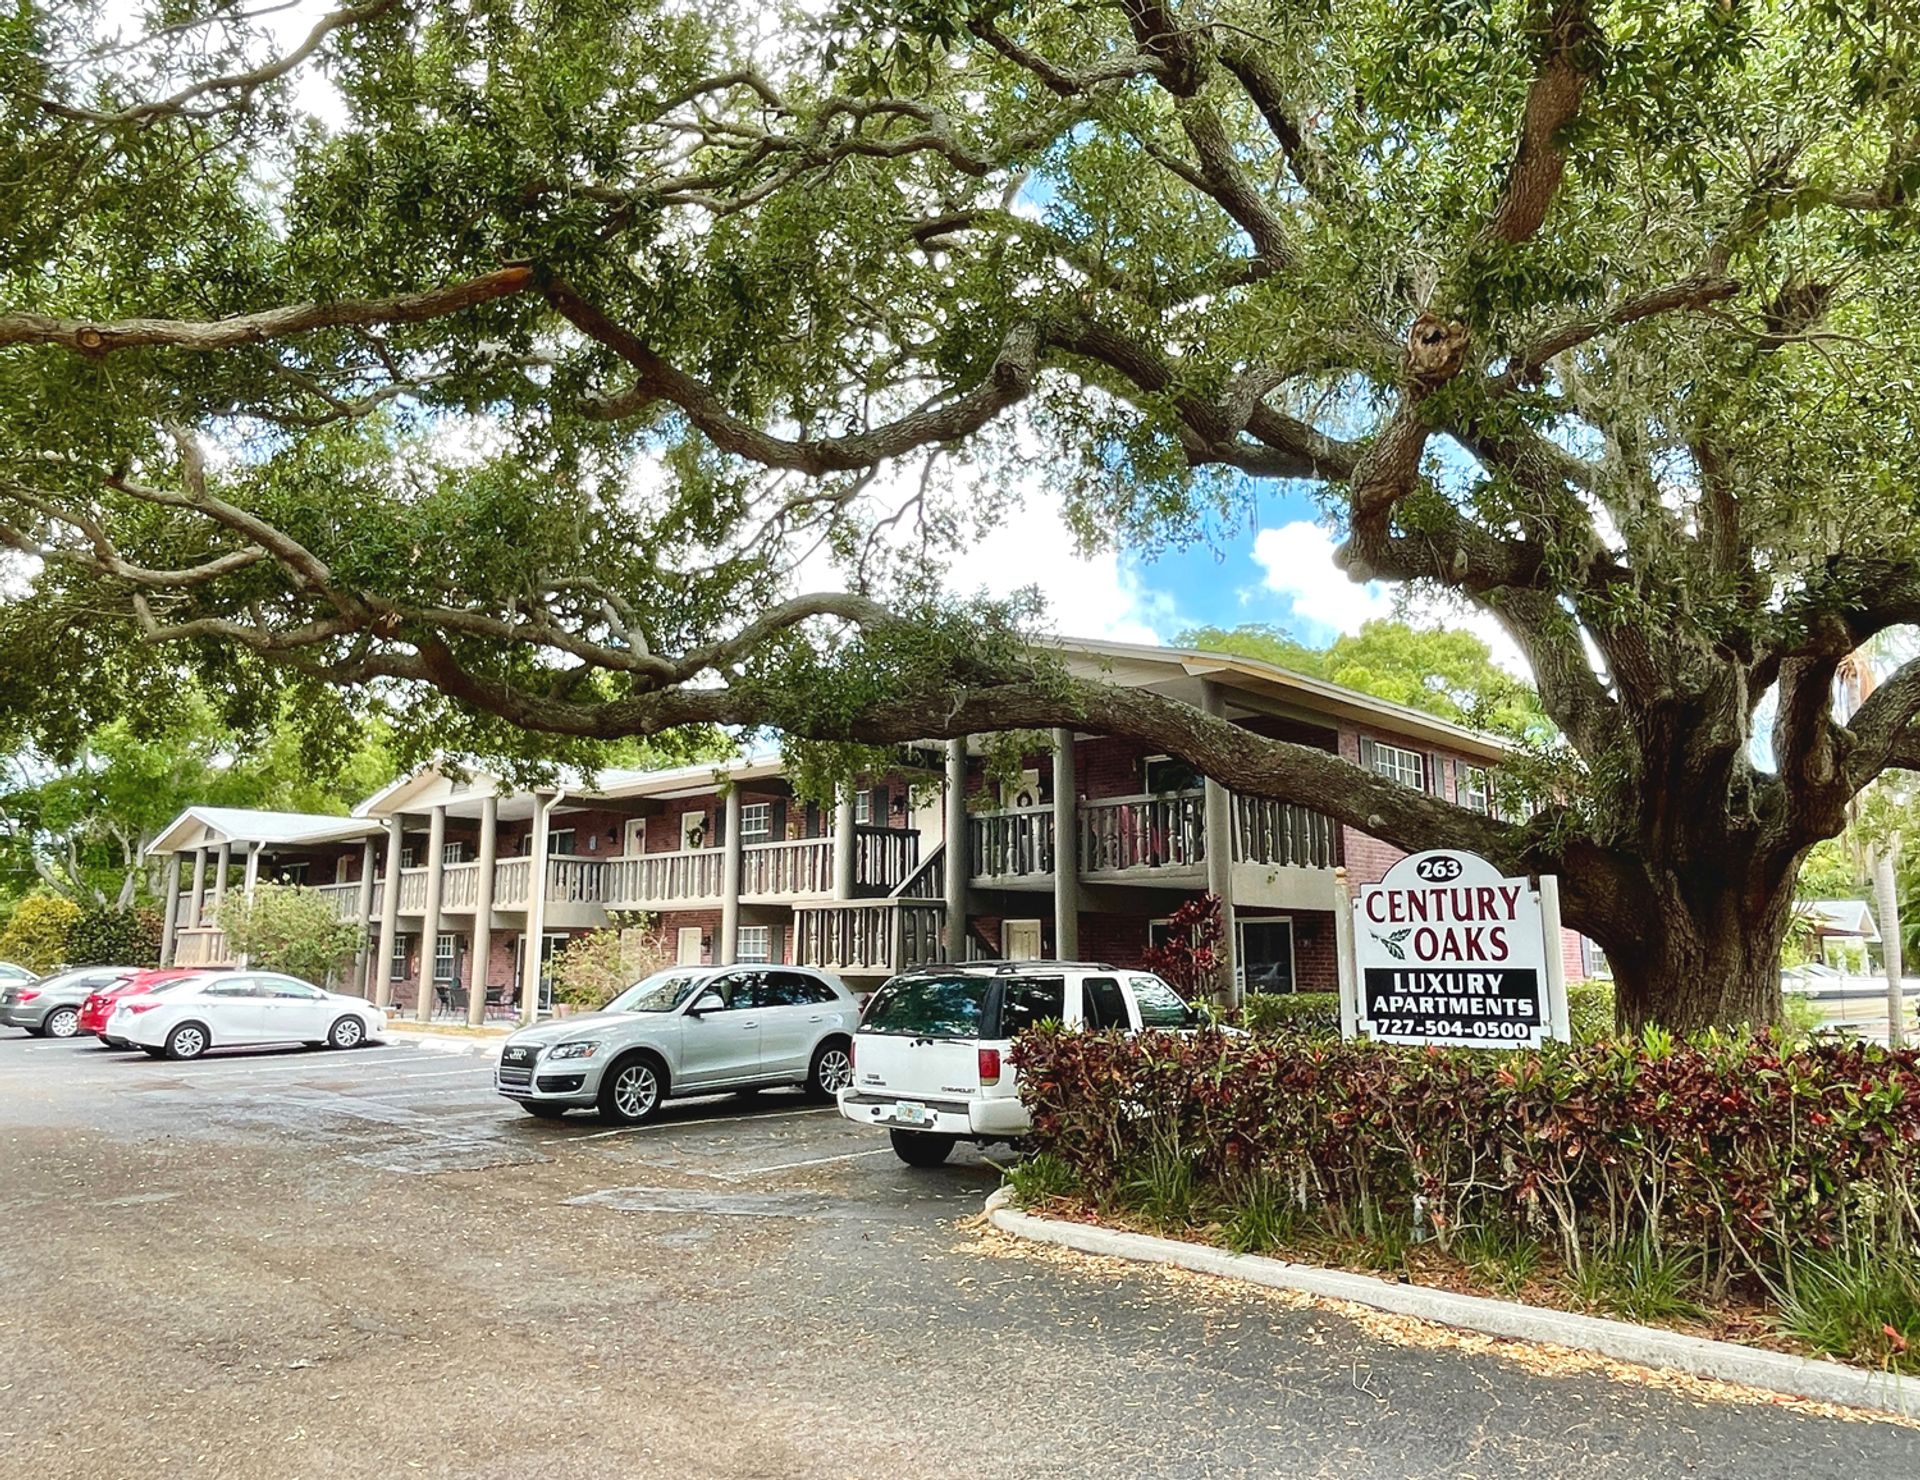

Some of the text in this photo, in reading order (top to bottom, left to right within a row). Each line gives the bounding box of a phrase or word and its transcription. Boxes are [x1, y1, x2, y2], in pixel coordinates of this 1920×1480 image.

[1420, 861, 1460, 878] 263
[1366, 886, 1521, 922] CENTURY
[1414, 927, 1509, 961] OAKS
[1394, 973, 1503, 994] LUXURY
[1373, 996, 1534, 1016] APARTMENTS
[1378, 1019, 1528, 1038] 727-504-0500
